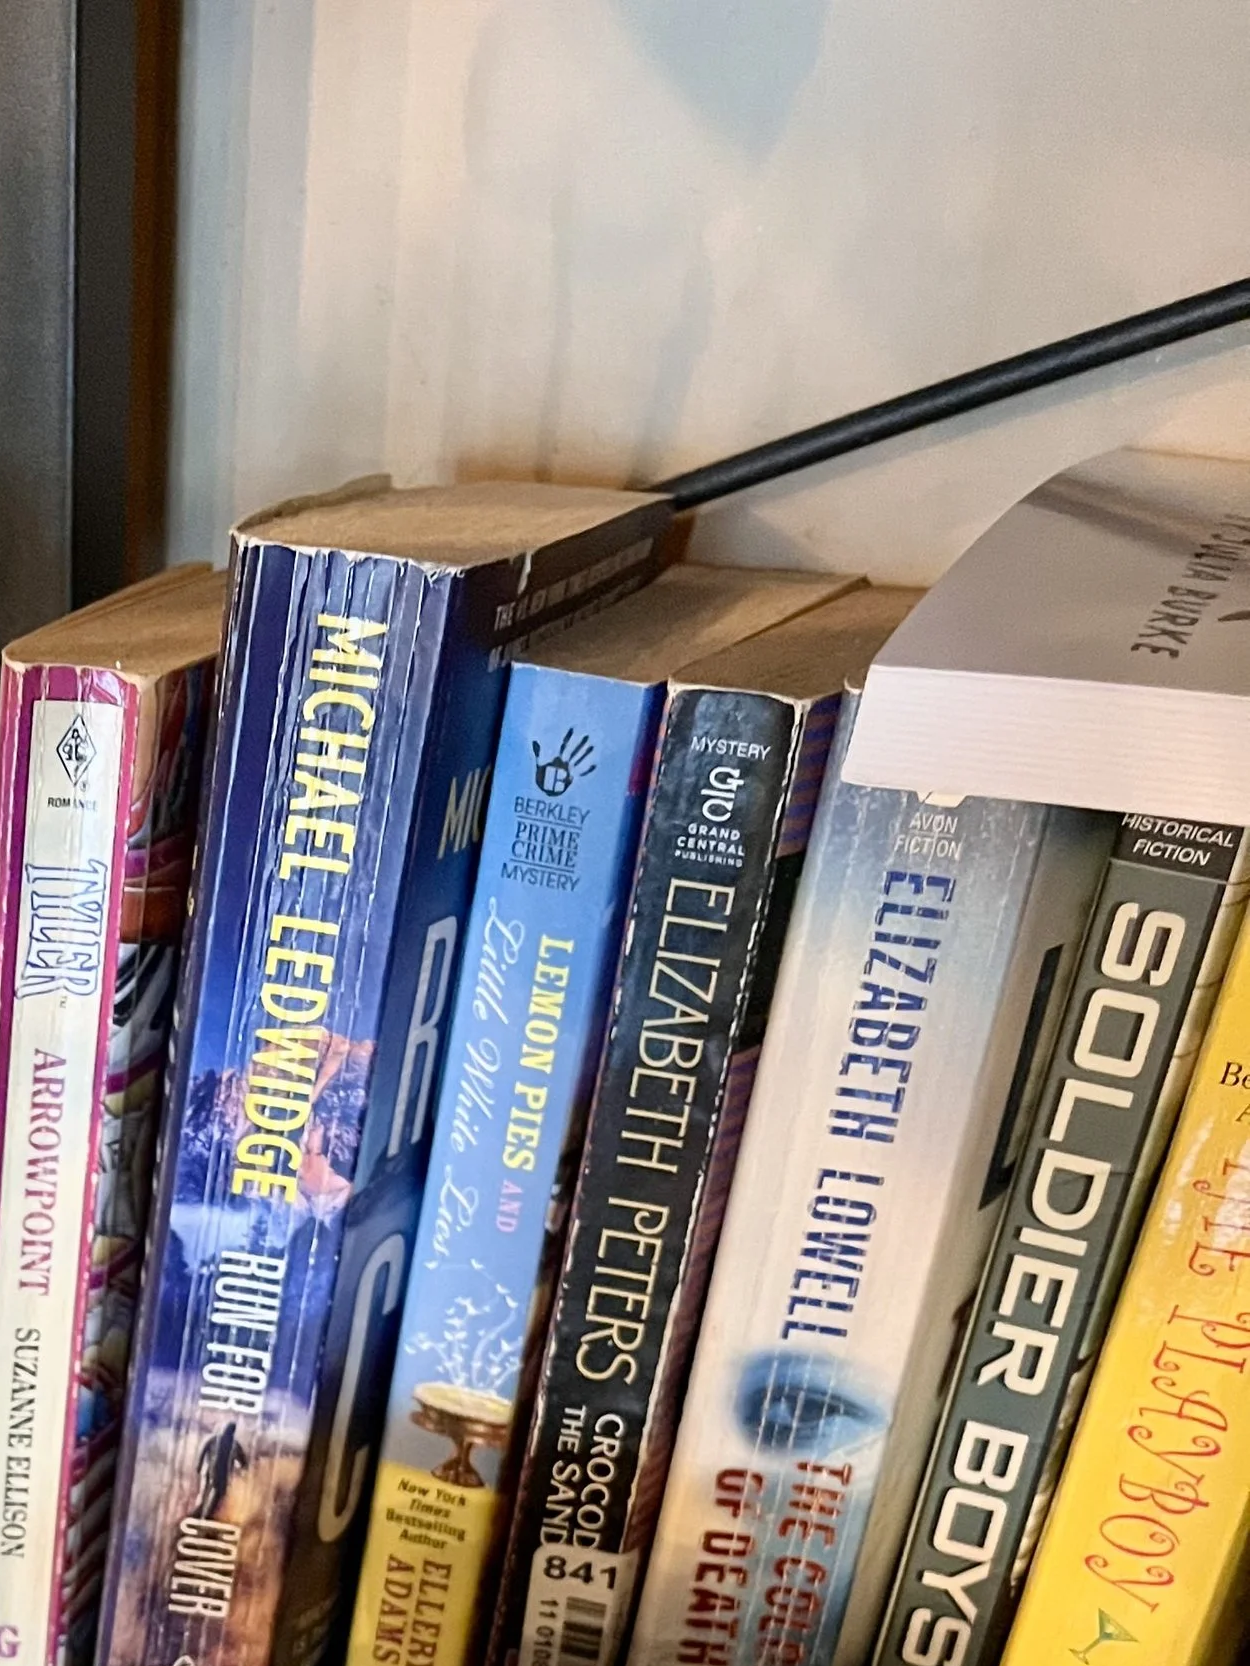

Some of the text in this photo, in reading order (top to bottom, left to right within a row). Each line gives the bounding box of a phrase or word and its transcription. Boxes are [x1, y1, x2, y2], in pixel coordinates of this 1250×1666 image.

[1130, 584, 1220, 660] BURKE
[689, 735, 771, 762] MYSTERY
[513, 795, 592, 826] BERKLEY
[687, 822, 741, 841] GRAND
[909, 810, 959, 835] AVON
[1122, 811, 1237, 849] HISTORICAL
[511, 841, 577, 870] CRIME
[515, 820, 581, 849] PRIME
[676, 836, 746, 857] CENTRAL
[894, 833, 963, 861] FICTION
[1132, 838, 1213, 867] FICTION
[501, 860, 580, 893] MYSTERY
[674, 849, 743, 869] PUBLISHING
[13, 858, 108, 999] TYLER
[231, 613, 389, 1206] MICHAEL LEDWIDGE
[615, 877, 737, 1174] ELIZABETH
[432, 896, 526, 1258] Little White Lies
[495, 933, 575, 1235] LEMON PIES AND
[781, 870, 957, 1340] ELIZABETH LOWELL
[977, 900, 1187, 1397] SOLDIER
[17, 1047, 68, 1297] ARROWPOINT
[575, 1196, 672, 1386] PETERS
[0, 1327, 41, 1559] SUZANNE ELLISON
[166, 1249, 289, 1620] RUN FOR COVER
[557, 1405, 587, 1455] THE
[1084, 1304, 1250, 1614] PLAYBOY
[397, 1478, 466, 1508] New York
[410, 1498, 451, 1519] Times
[715, 1466, 765, 1520] OF
[778, 1461, 853, 1550] THE
[386, 1507, 466, 1542] Bestselling
[398, 1528, 448, 1551] Author
[543, 1555, 619, 1590] 841
[372, 1553, 417, 1666] ADAMS
